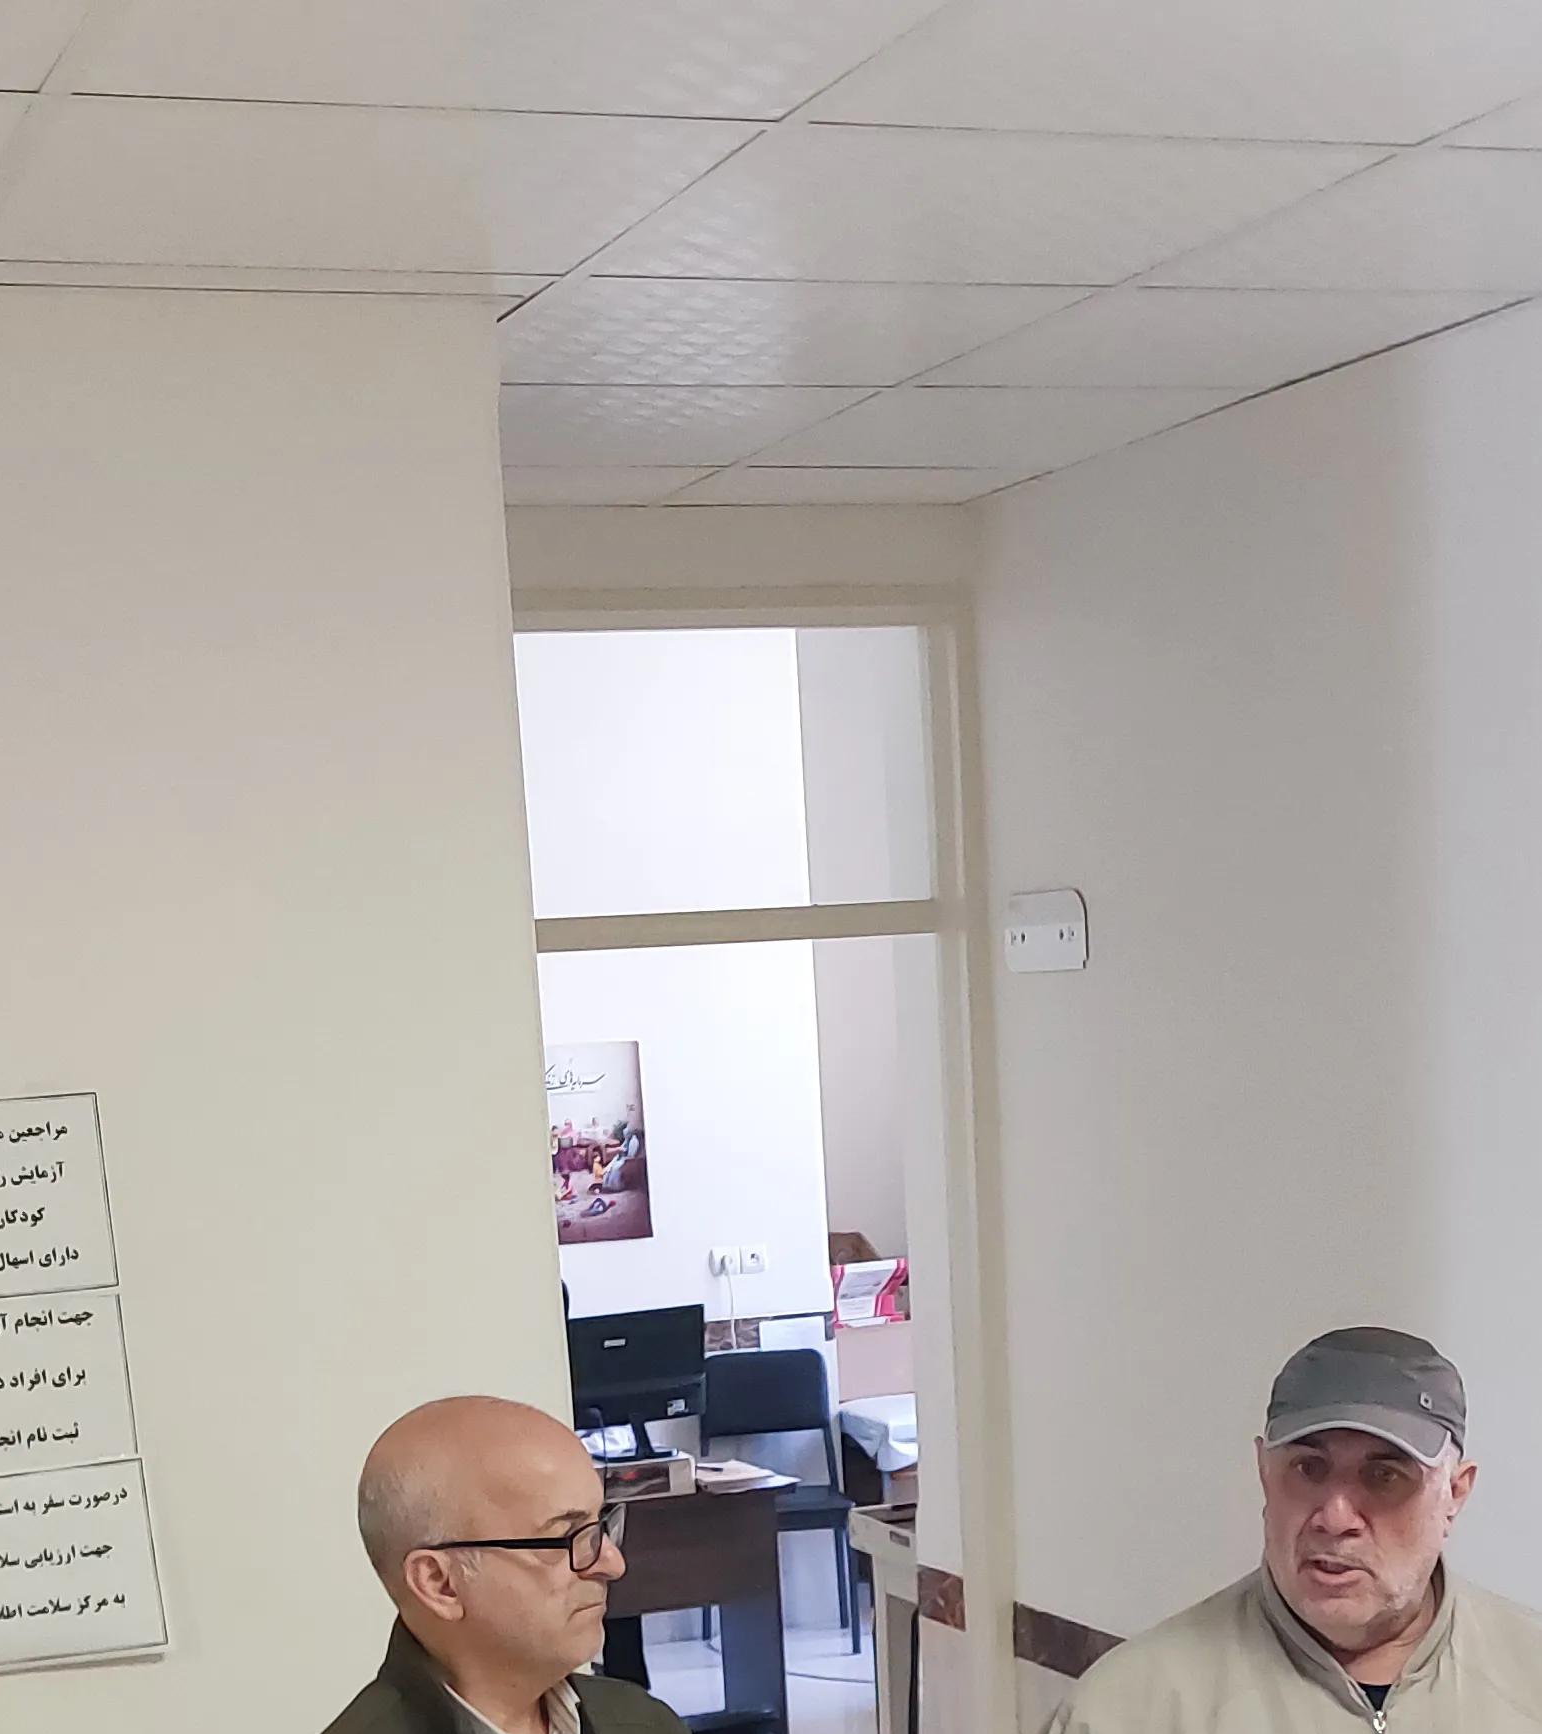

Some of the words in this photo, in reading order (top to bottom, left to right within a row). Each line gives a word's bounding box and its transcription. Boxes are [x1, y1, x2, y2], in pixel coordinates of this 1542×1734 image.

[9, 1122, 68, 1142] مراجعین
[11, 1162, 64, 1185] آزمایش
[39, 1247, 79, 1266] دارای
[15, 1310, 52, 1334] انجام
[58, 1310, 93, 1326] جهت
[10, 1368, 46, 1391] افراد
[52, 1366, 86, 1387] برای
[27, 1427, 47, 1448] نام
[52, 1422, 79, 1443] ثبت
[23, 1501, 35, 1516] به
[42, 1494, 64, 1514] سفر
[24, 1545, 76, 1569] ارزیابی
[80, 1543, 113, 1559] جهت
[27, 1597, 71, 1617] سلامت
[77, 1595, 108, 1615] مرکز
[113, 1593, 125, 1608] به
